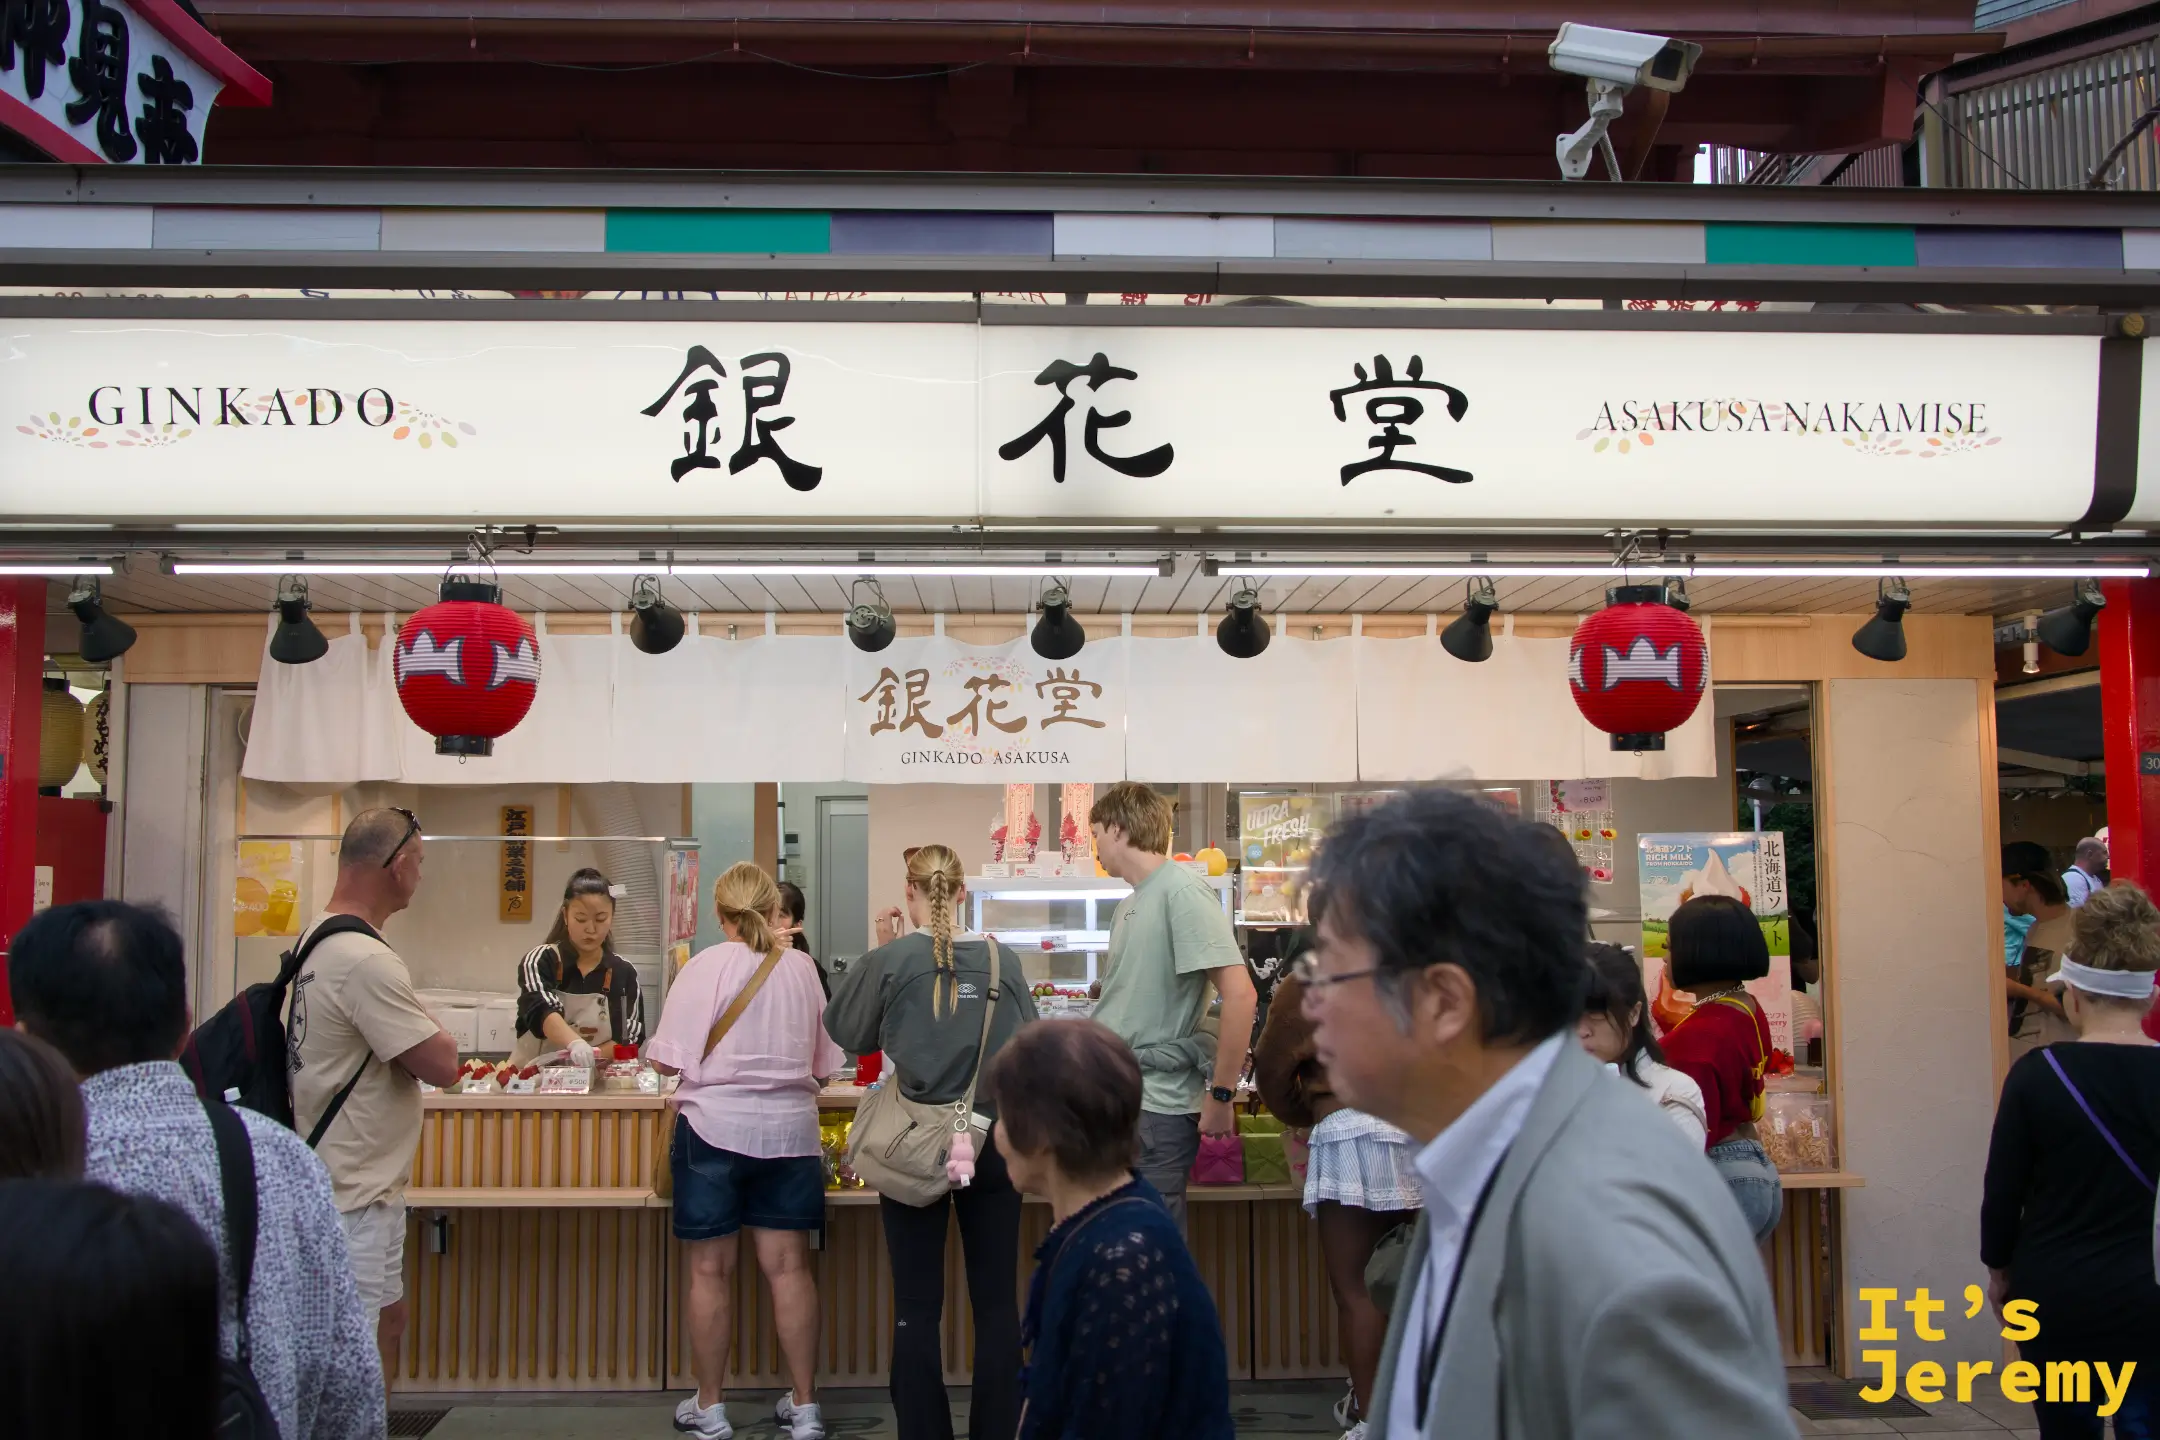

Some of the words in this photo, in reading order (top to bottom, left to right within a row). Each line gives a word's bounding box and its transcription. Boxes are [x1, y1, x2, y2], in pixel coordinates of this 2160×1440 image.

[88, 386, 394, 427] GINKADO
[641, 345, 1474, 492] 銀花堂
[1592, 400, 1770, 432] ASAKUSA
[1783, 402, 1987, 433] NAKAMISE
[860, 667, 1106, 738] 銀花堂
[901, 751, 983, 765] GINKADO
[993, 751, 1071, 765] ASAKUSA
[1246, 799, 1289, 832] ULTRA
[1263, 812, 1311, 848] FRESH
[1645, 844, 1693, 853] 北海道ソフト
[1645, 853, 1668, 861] RICH
[1670, 853, 1693, 861] MILK
[1764, 840, 1783, 947] 北海道ソフト
